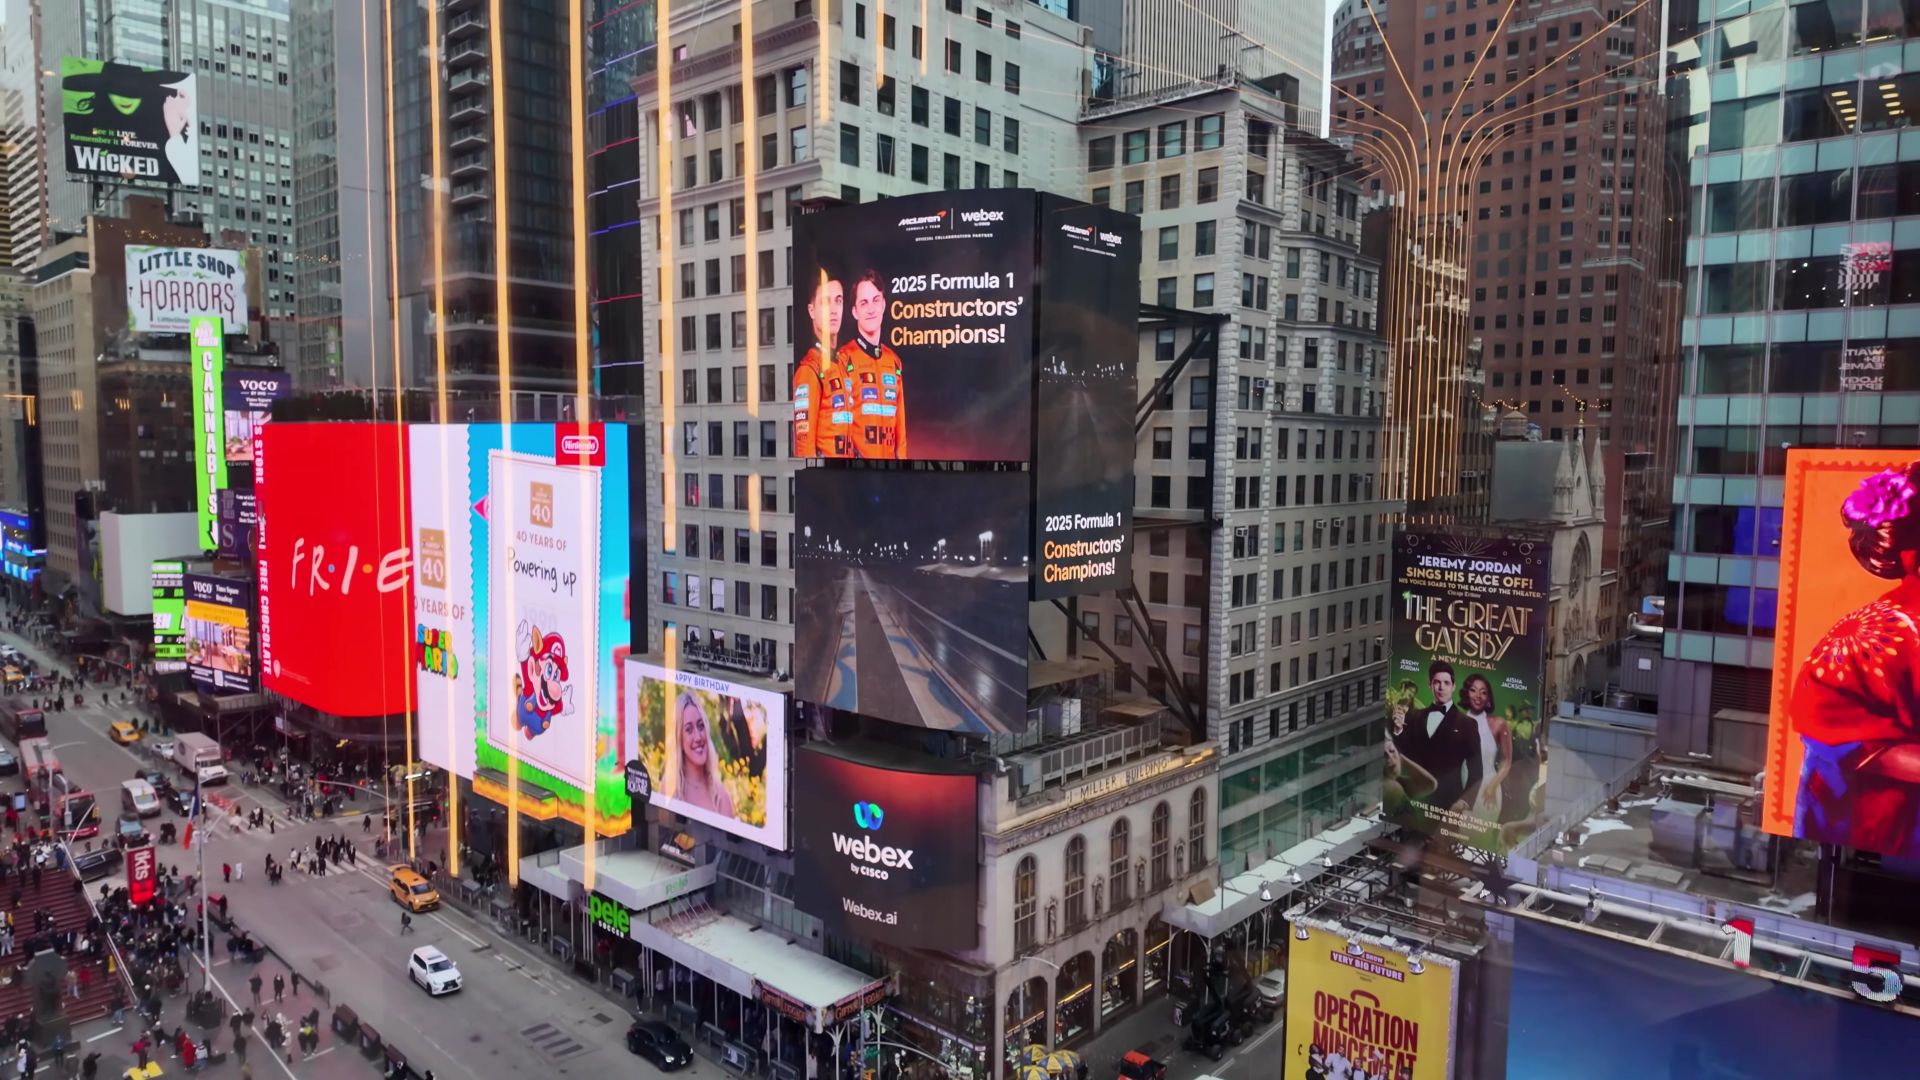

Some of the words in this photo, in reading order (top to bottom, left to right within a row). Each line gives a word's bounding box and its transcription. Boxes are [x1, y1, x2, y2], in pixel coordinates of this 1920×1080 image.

[961, 208, 1004, 222] webex
[139, 251, 193, 275] LITTLE
[197, 254, 236, 279] SHOP
[891, 275, 927, 294] 2025
[930, 271, 1000, 290] Formula
[1005, 272, 1014, 288] 1
[140, 279, 235, 324] HORRORS
[890, 323, 1006, 349] Champions!
[202, 351, 219, 514] CANNABIS
[563, 440, 597, 451] Nintendo
[255, 439, 264, 484] STORE
[532, 504, 552, 524] 40
[1045, 515, 1073, 532] 2025
[1074, 512, 1114, 530] Formula
[1116, 512, 1122, 527] 1
[516, 531, 528, 543] 40
[529, 533, 554, 551] YEARS
[556, 539, 567, 551] OF
[259, 559, 269, 593] FREE
[422, 557, 444, 582] 40
[508, 547, 558, 593] Powering
[563, 570, 578, 597] up
[1044, 557, 1116, 583] Champions!
[1406, 567, 1442, 581] SINGS
[1445, 571, 1466, 583] HIS
[1468, 573, 1501, 587] FACE
[1503, 576, 1534, 590] OFF!
[1468, 560, 1522, 575] JORDAN
[1409, 578, 1427, 587] VOICE
[1427, 580, 1448, 589] SOARS
[1457, 583, 1470, 591] THE
[1470, 585, 1488, 593] BACK
[1499, 588, 1511, 596] THE
[420, 597, 449, 617] YEARS
[452, 604, 466, 620] OF
[1404, 591, 1442, 624] THE
[1447, 600, 1533, 636] GREAT
[260, 595, 272, 675] CHOCOLATE
[417, 623, 452, 652] SUPER
[1415, 624, 1515, 662] GATSBY
[415, 642, 459, 680] MARIO
[1399, 664, 1420, 673] JORDAN
[1400, 658, 1420, 667] JEREMY
[1438, 655, 1458, 664] NEW
[1459, 659, 1497, 671] MUSICAL
[693, 677, 730, 693] BIRTHDAY
[1080, 772, 1117, 800] MILLER
[1125, 754, 1170, 784] BUILDING
[1430, 804, 1468, 821] BROADWAY
[1470, 815, 1503, 830] THEATRE
[1448, 817, 1488, 833] BROADWAY
[832, 832, 914, 870] webex
[135, 850, 151, 880] tkts
[850, 863, 859, 875] by
[860, 866, 889, 880] CISCO
[842, 896, 898, 925] Webex.ai
[1332, 952, 1353, 965] VERY
[1354, 958, 1370, 971] BIG
[1370, 964, 1403, 981] FUTURE
[1720, 917, 1755, 969] 1
[1852, 942, 1904, 1002] 5
[1313, 990, 1419, 1053] OPERATION
